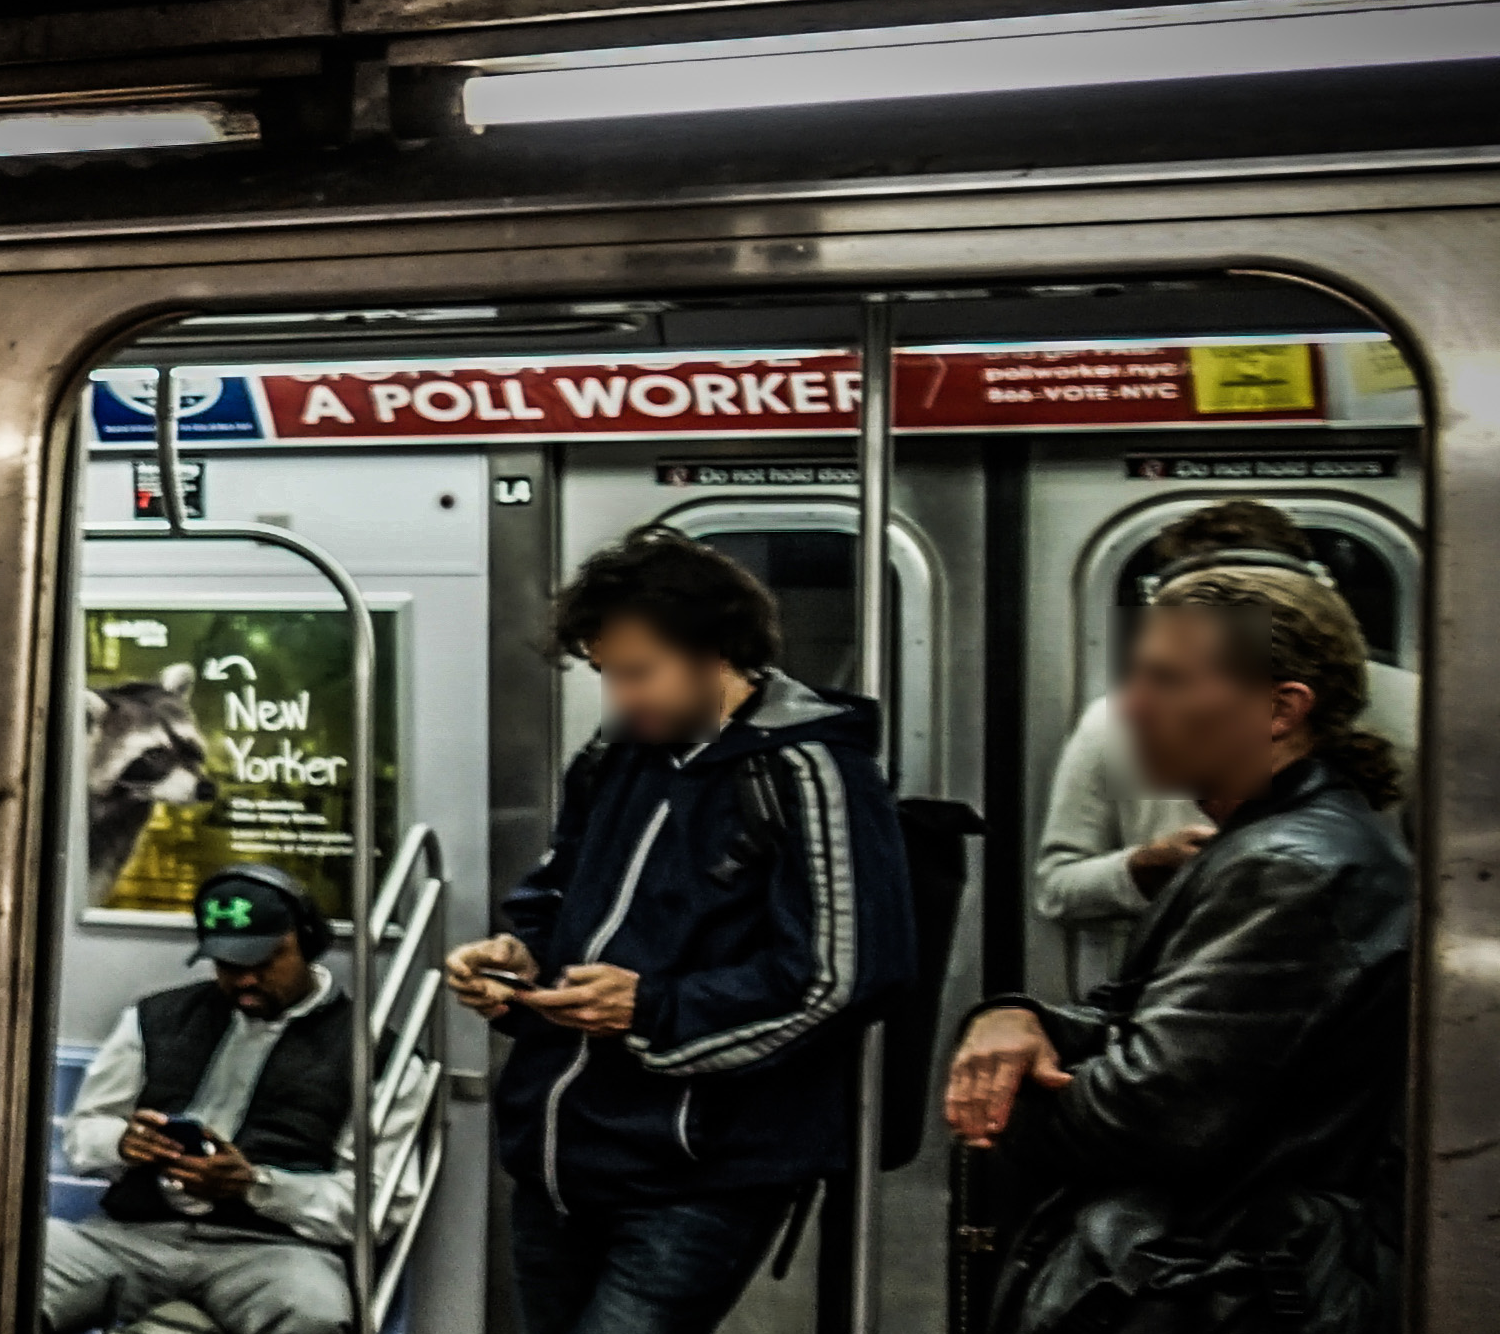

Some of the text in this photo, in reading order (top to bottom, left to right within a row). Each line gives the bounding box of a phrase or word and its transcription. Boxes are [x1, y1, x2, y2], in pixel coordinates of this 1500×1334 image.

[302, 371, 863, 425] A POLL WORKER
[224, 684, 310, 731] New
[223, 734, 348, 786] Yorker
